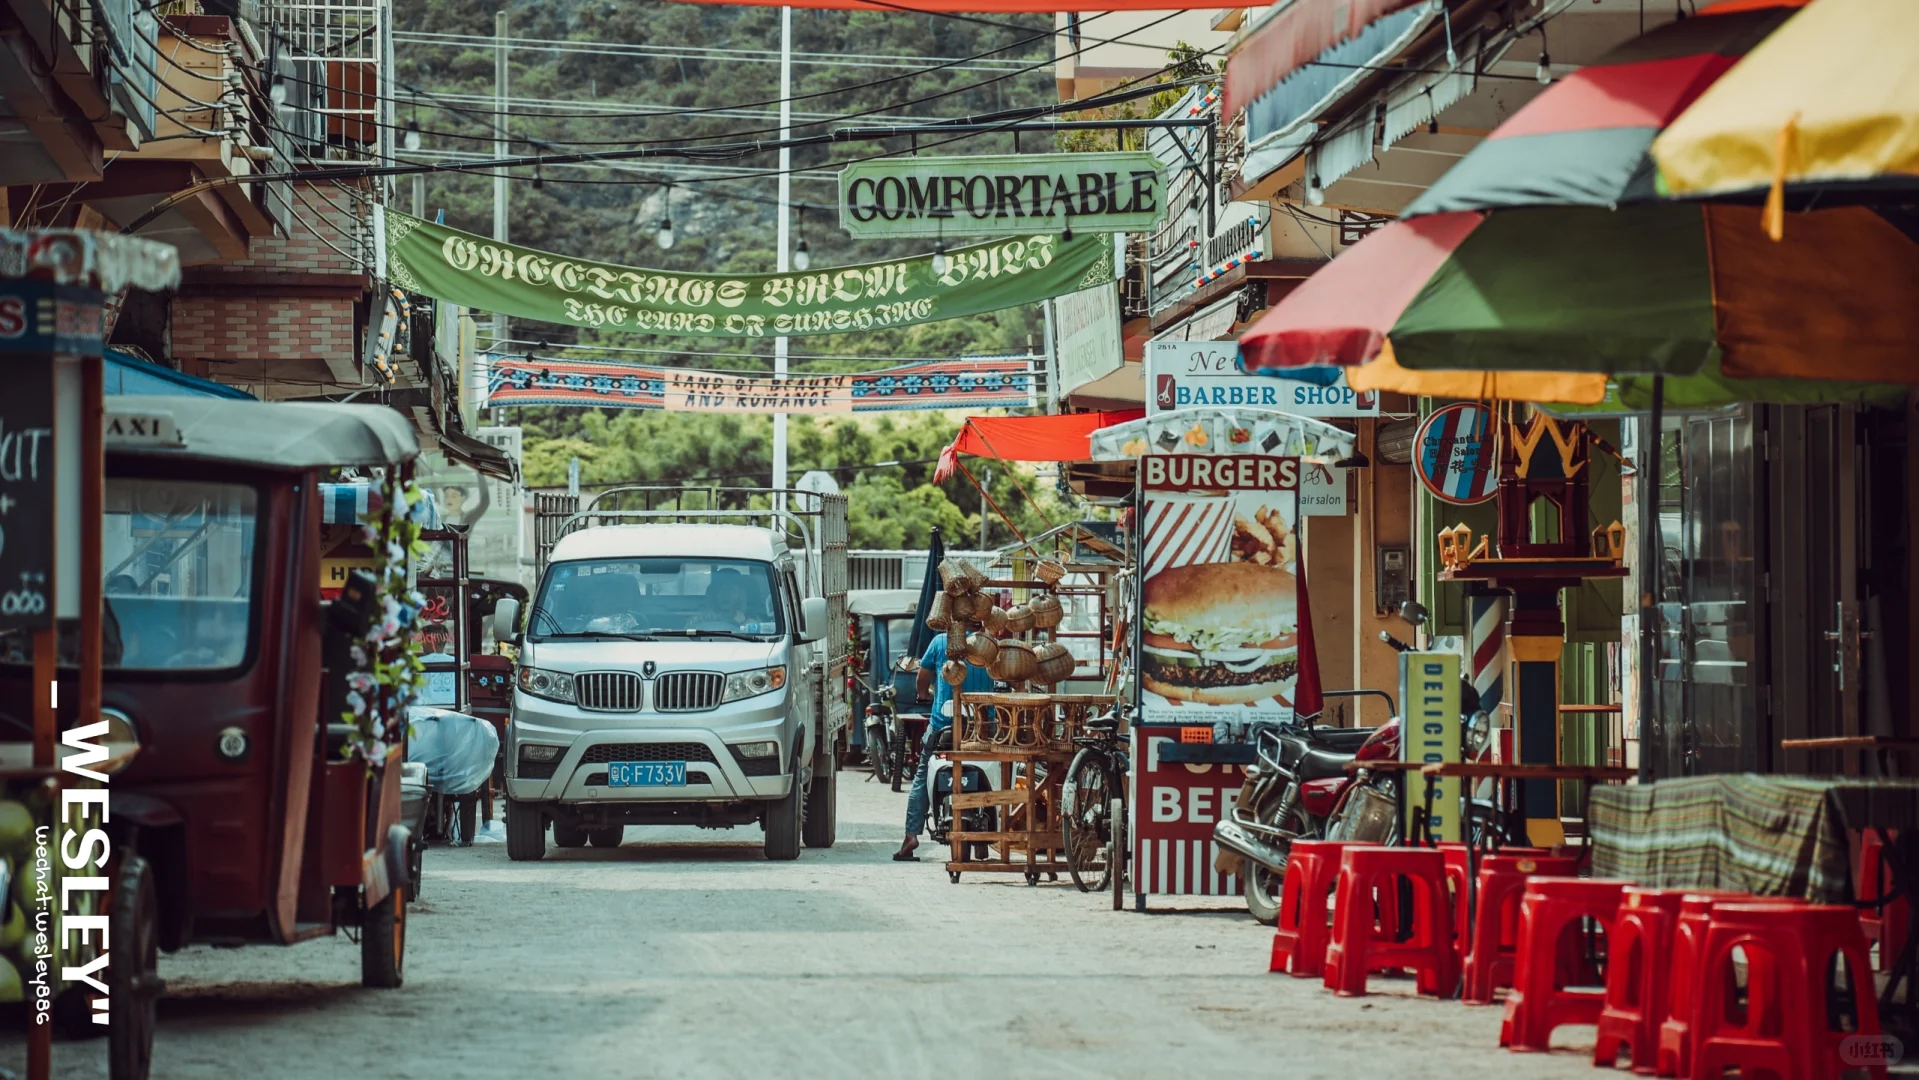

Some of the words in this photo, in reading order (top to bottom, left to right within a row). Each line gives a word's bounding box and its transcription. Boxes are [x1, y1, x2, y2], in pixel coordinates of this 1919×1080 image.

[848, 170, 1159, 222] COMFORTABLE
[563, 298, 628, 328] THE
[636, 309, 716, 333] LAND
[773, 298, 932, 332] SUNSHINE
[672, 373, 723, 389] LAND
[769, 375, 845, 391] BEAUTY
[685, 389, 724, 407] AND
[736, 390, 832, 407] ROMANCE
[1176, 386, 1278, 405] BARBER
[1294, 386, 1356, 405] SHOP
[107, 419, 160, 437] AXI
[1146, 457, 1297, 487] BURGERS
[1316, 494, 1341, 505] salon
